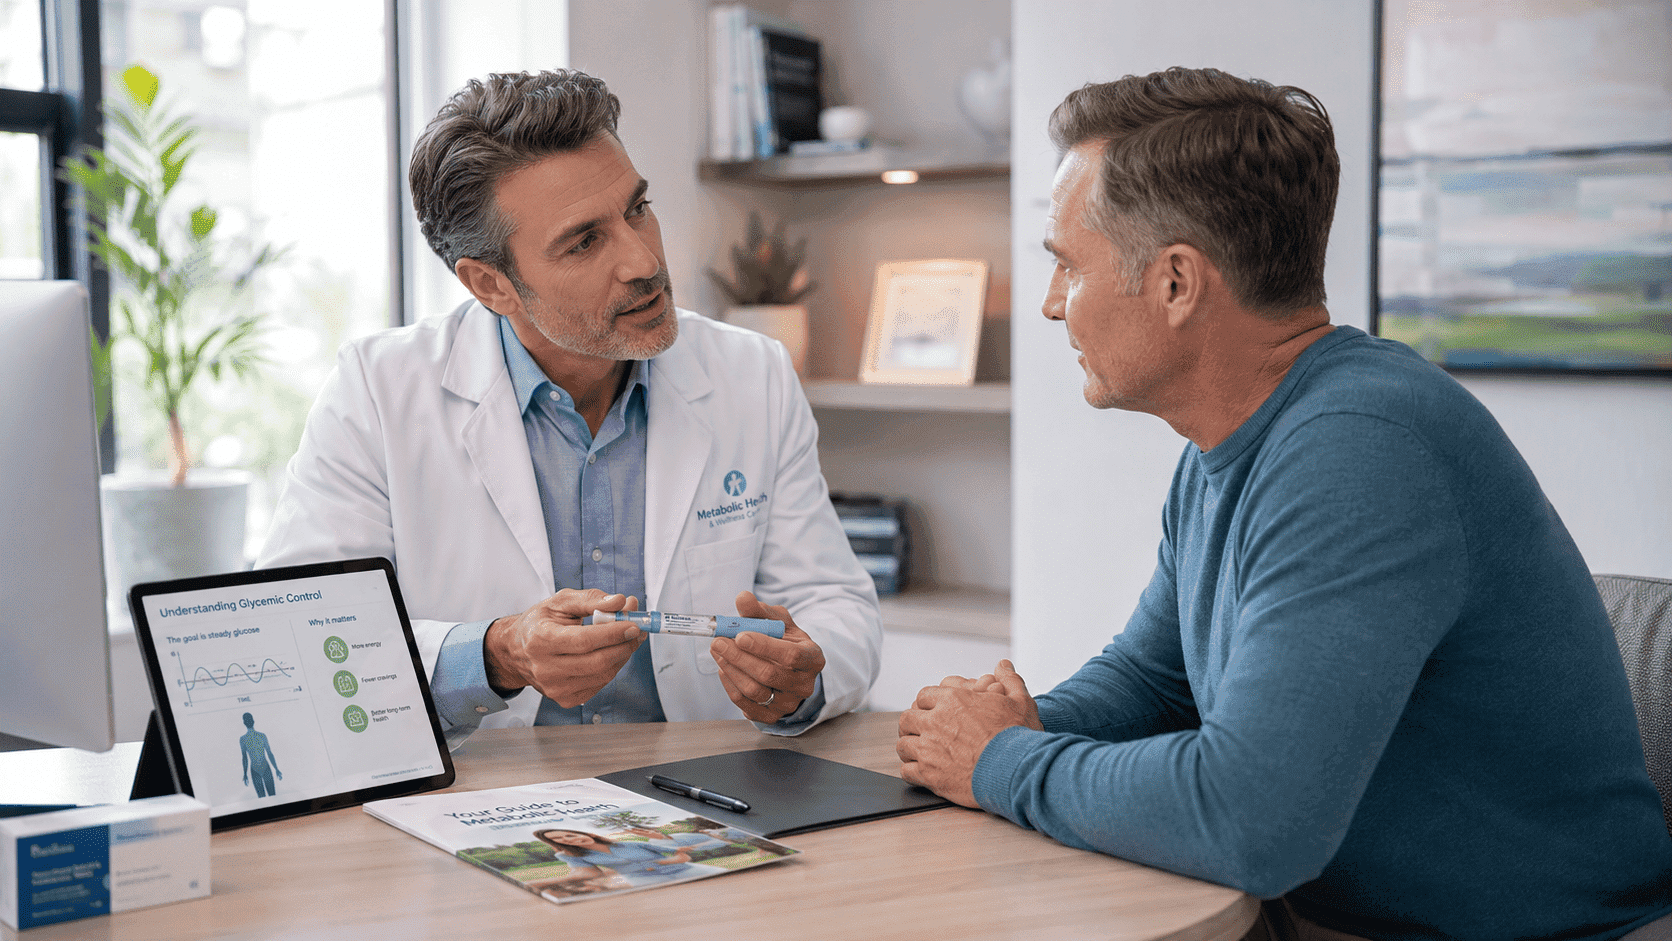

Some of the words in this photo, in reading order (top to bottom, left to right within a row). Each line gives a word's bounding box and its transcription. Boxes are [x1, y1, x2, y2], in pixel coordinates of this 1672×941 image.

[697, 501, 743, 521] Metabolic
[159, 601, 237, 618] Understanding
[239, 595, 284, 609] Glycemic
[286, 590, 323, 603] Control
[308, 618, 324, 627] Why
[331, 615, 357, 624] matters
[166, 636, 181, 644] The
[183, 632, 199, 644] goal
[200, 632, 207, 640] is
[208, 629, 232, 640] steady
[233, 626, 260, 638] glucose
[443, 809, 491, 819] Your
[495, 801, 554, 814] Guide
[459, 810, 557, 826] Metabolic
[554, 803, 620, 816] Health
